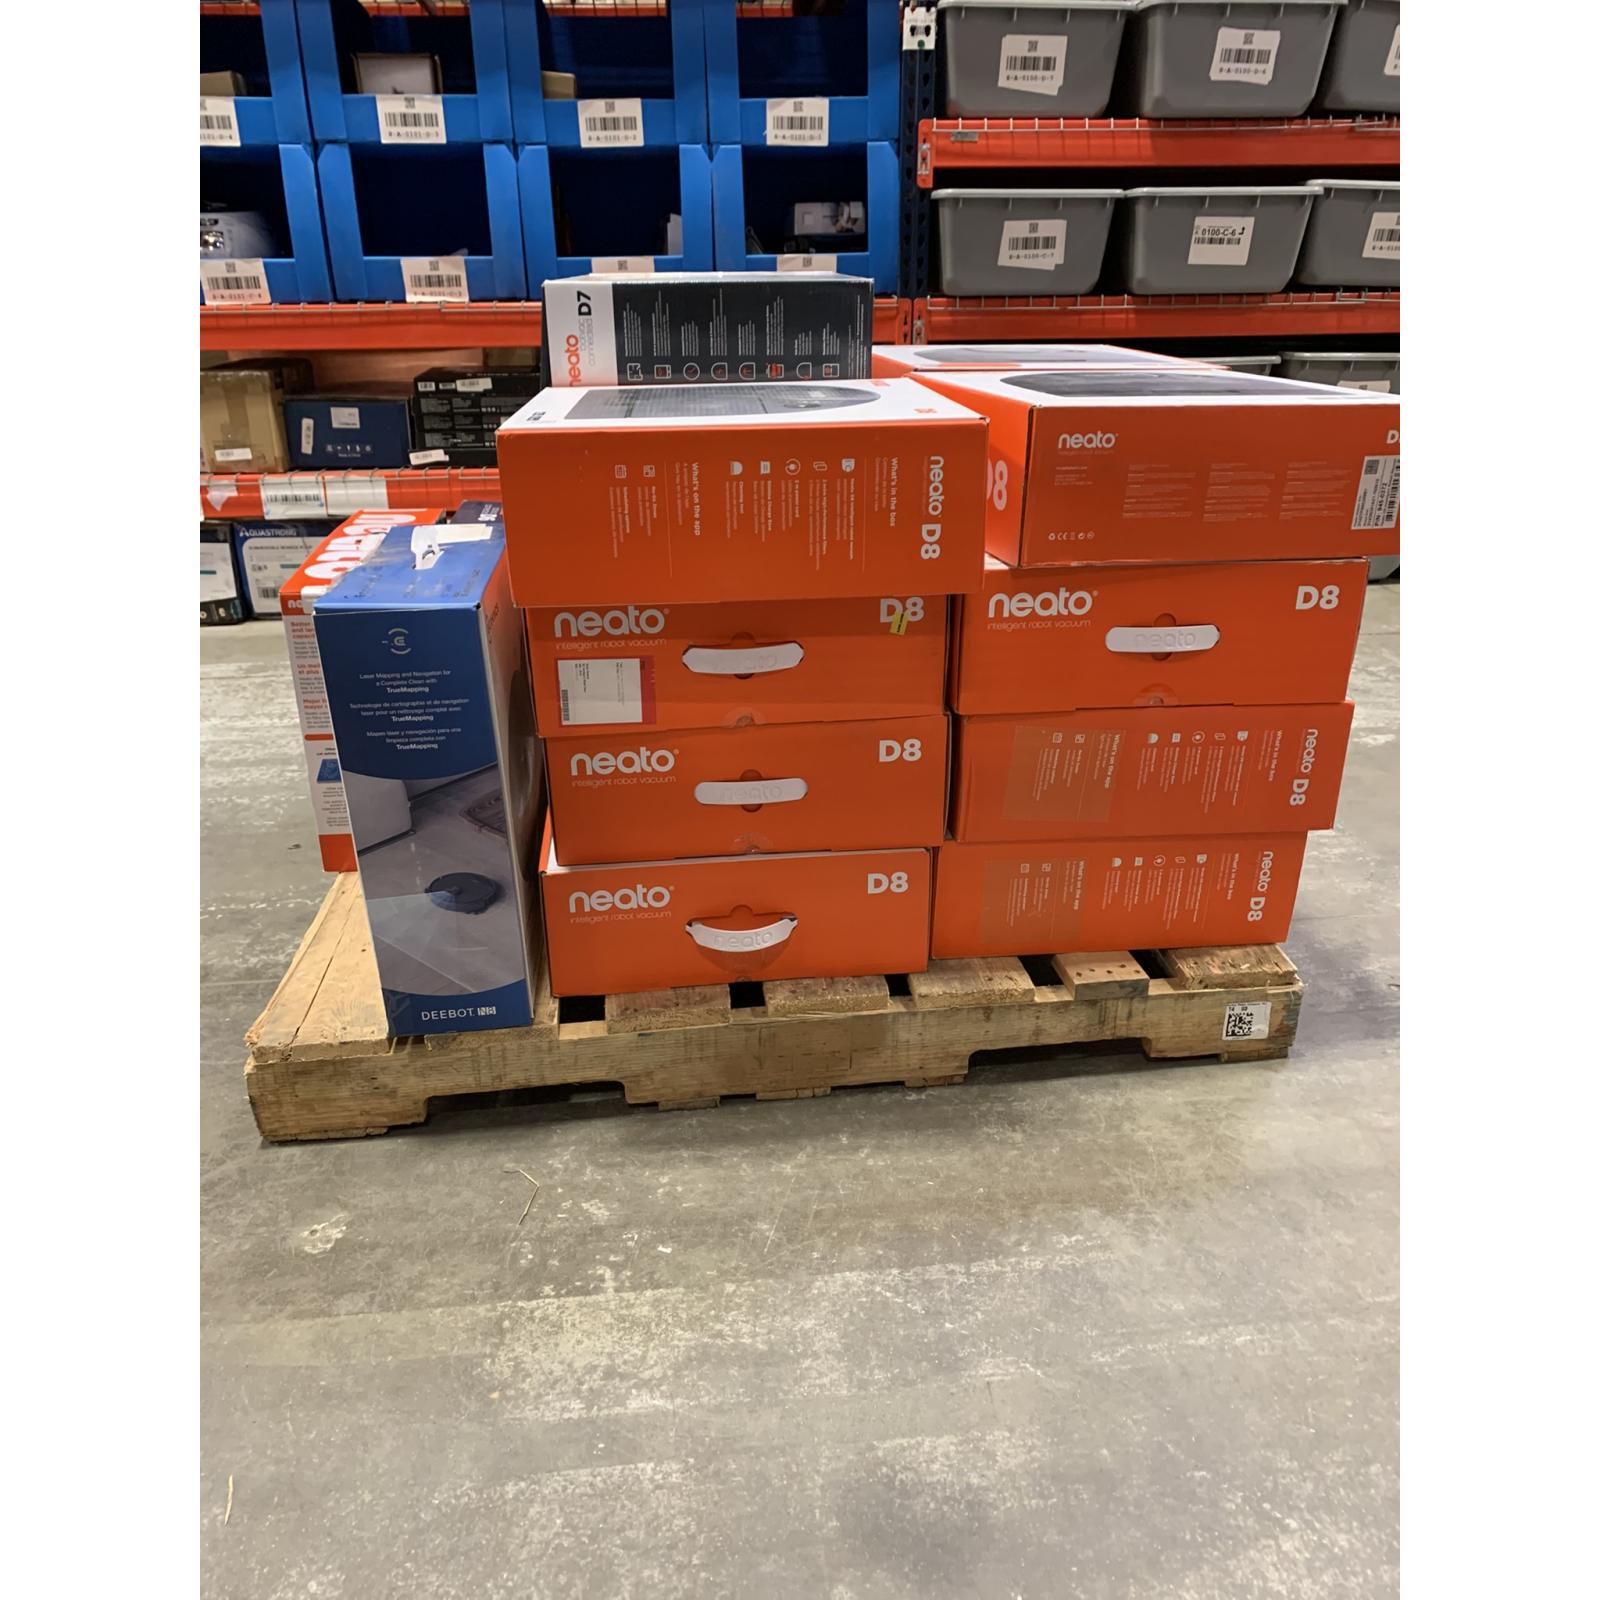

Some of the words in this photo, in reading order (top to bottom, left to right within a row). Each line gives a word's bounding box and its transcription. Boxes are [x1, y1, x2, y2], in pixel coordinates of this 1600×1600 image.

[1201, 228, 1237, 237] 0100-C-6
[576, 290, 592, 316] D7
[1058, 431, 1116, 448] neato
[890, 457, 898, 486] What's
[928, 455, 944, 516] neato
[693, 493, 699, 503] on
[240, 527, 297, 537] AQUASTRONG
[920, 524, 942, 560] D8
[988, 587, 1092, 618] neato
[1295, 586, 1340, 610] D8
[554, 606, 665, 638] neato
[880, 596, 924, 623] D8
[987, 620, 1026, 631] intelligent
[1029, 620, 1052, 628] robot
[1054, 620, 1091, 628] vacuum
[555, 640, 598, 651] intelligent
[600, 640, 625, 648] robot
[627, 639, 667, 647] vacuum
[387, 686, 429, 694] TrueMapping
[392, 715, 434, 723] TrueMapping
[396, 743, 438, 751] TrueMapping
[570, 746, 675, 777] neato
[878, 738, 922, 763] D8
[1300, 729, 1319, 773] neato
[571, 777, 611, 789] intelligent
[614, 776, 637, 785] robot
[640, 775, 676, 784] vacuum
[1290, 778, 1310, 806] D8
[1257, 851, 1274, 891] neato
[568, 884, 670, 913] neato
[867, 872, 908, 894] D8
[570, 914, 608, 925] intelligent
[611, 913, 633, 921] robot
[636, 911, 672, 919] vacuum
[1247, 897, 1265, 922] D8
[422, 1008, 474, 1021] DEEBOT
